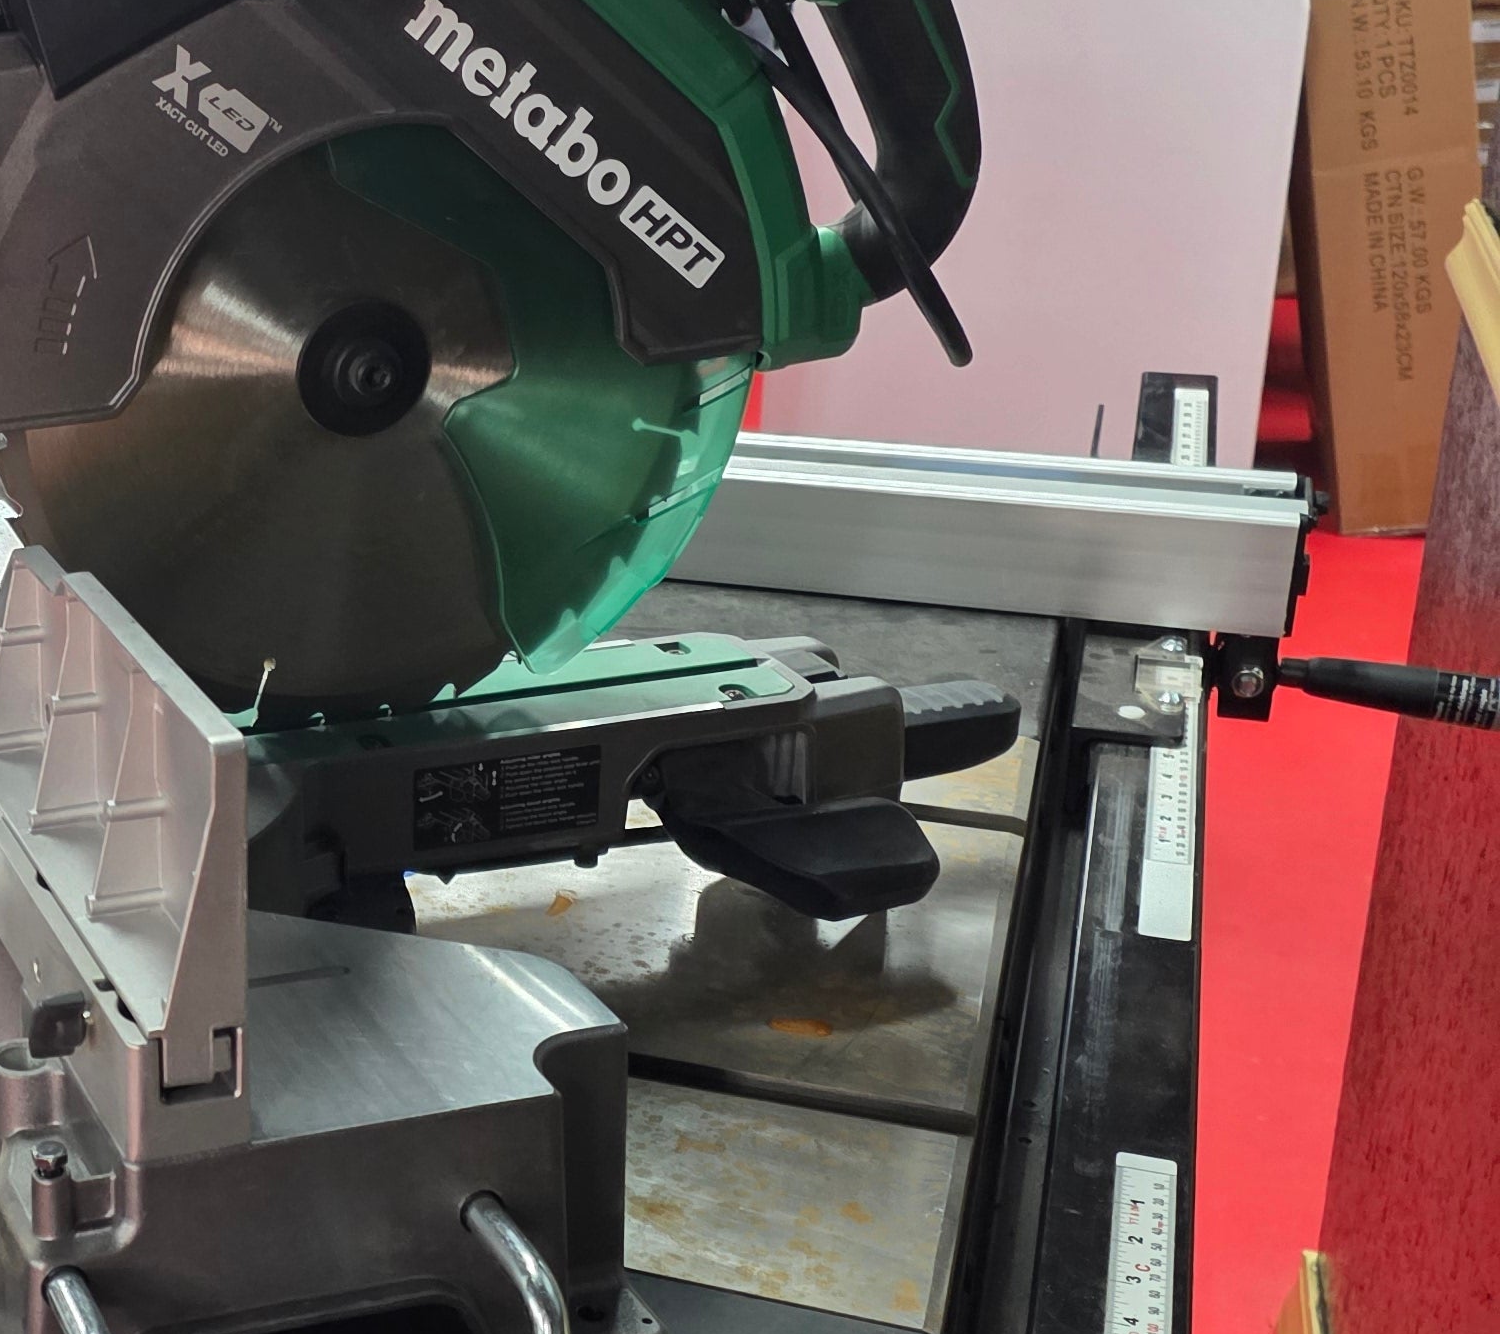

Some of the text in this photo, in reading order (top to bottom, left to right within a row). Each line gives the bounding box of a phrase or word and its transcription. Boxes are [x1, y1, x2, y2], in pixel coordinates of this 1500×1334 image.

[1376, 55, 1397, 100] PCS
[151, 43, 213, 110] X
[207, 96, 256, 132] LED
[155, 96, 229, 158] XACT CUT LED
[1359, 110, 1379, 152] KGS
[1384, 170, 1402, 208] CTN
[628, 198, 718, 274] HPT
[1363, 172, 1389, 313] MADE IN CHINA
[1414, 274, 1433, 315] KGS
[1152, 1197, 1164, 1206] 20
[1151, 1227, 1163, 1235] 40
[1128, 1235, 1143, 1244] 2
[1150, 1242, 1162, 1251] 50
[1149, 1258, 1162, 1266] 60
[1125, 1275, 1141, 1284] 3
[1149, 1274, 1161, 1282] 70
[1148, 1290, 1160, 1299] 80
[1148, 1306, 1160, 1315] 90
[1123, 1317, 1139, 1326] 4
[1147, 1323, 1160, 1334] 100
